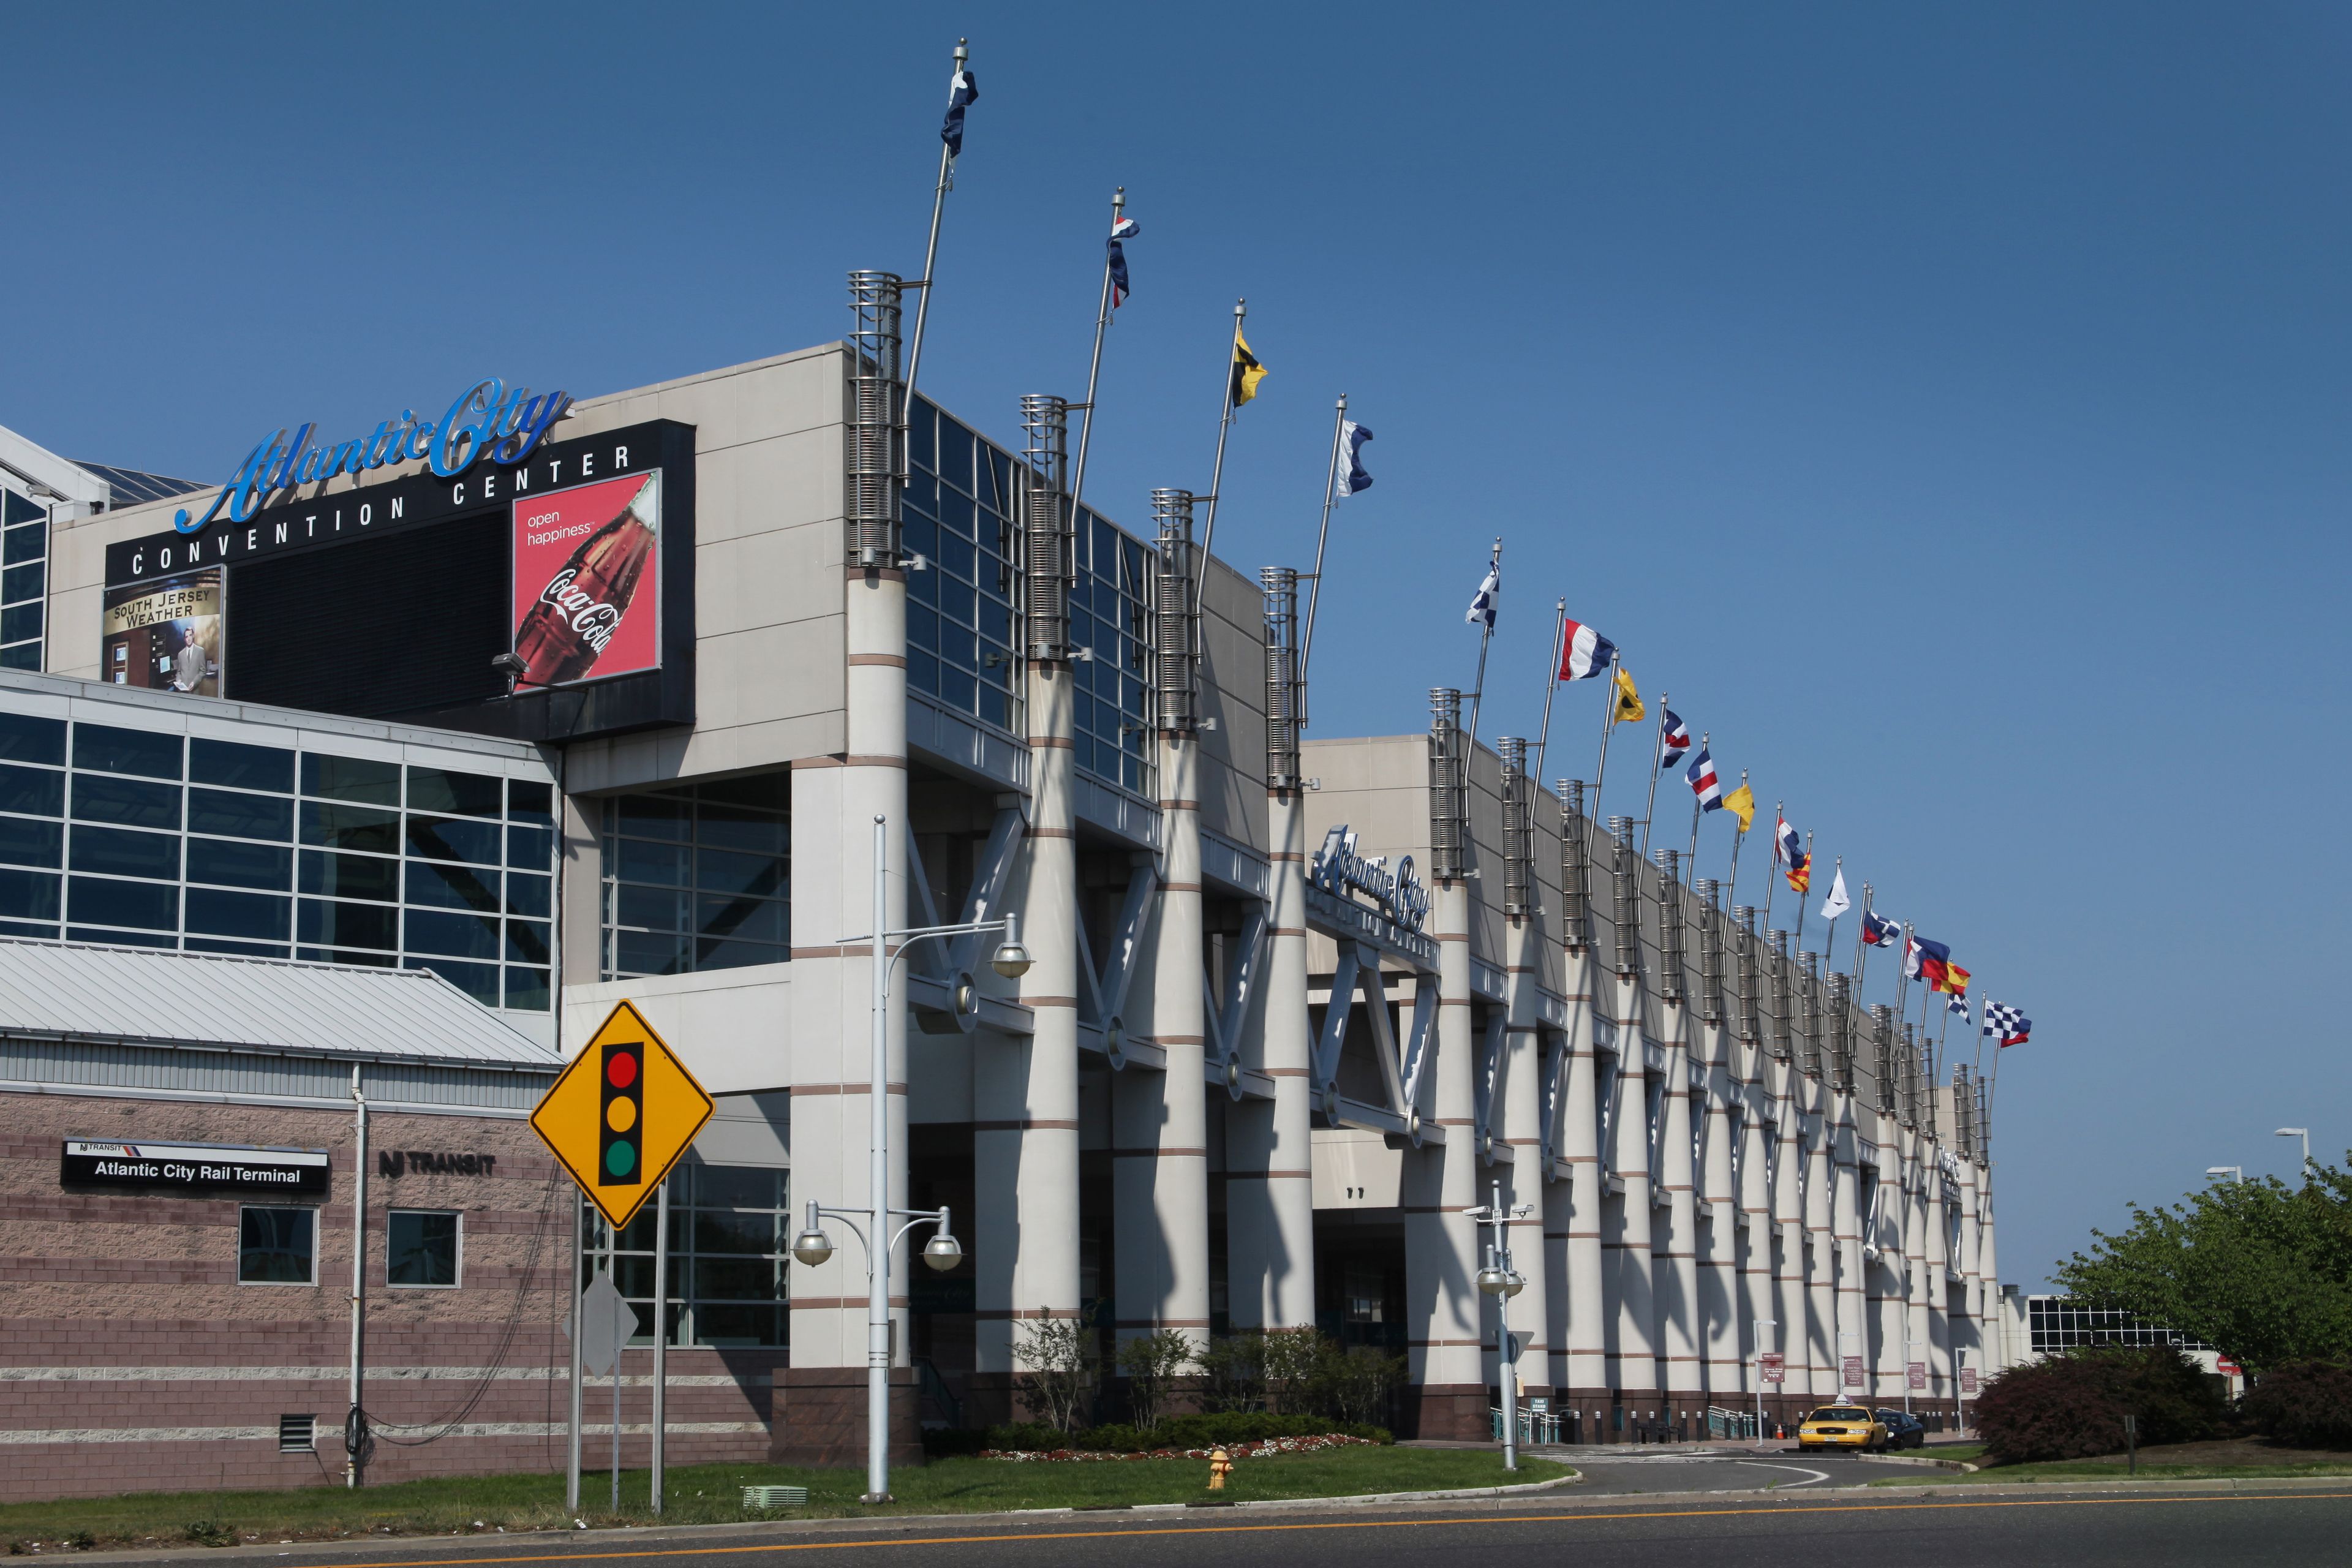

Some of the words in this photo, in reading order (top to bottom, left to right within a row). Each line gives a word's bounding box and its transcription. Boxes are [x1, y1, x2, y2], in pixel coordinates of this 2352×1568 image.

[174, 409, 437, 533] Atlantic
[429, 375, 574, 478] City
[132, 496, 403, 575] CONVENTION
[453, 445, 628, 505] CENTER
[527, 510, 560, 528] open
[114, 598, 153, 619] SOUTH
[158, 590, 209, 607] JERSEY
[126, 605, 193, 628] WEATHER
[540, 568, 620, 655] Coca-Cola
[95, 1161, 159, 1178] Atlantic
[164, 1164, 196, 1181] City
[200, 1166, 231, 1181] Rail
[233, 1167, 301, 1183] Terminal
[406, 1151, 496, 1177] TRANSIT
